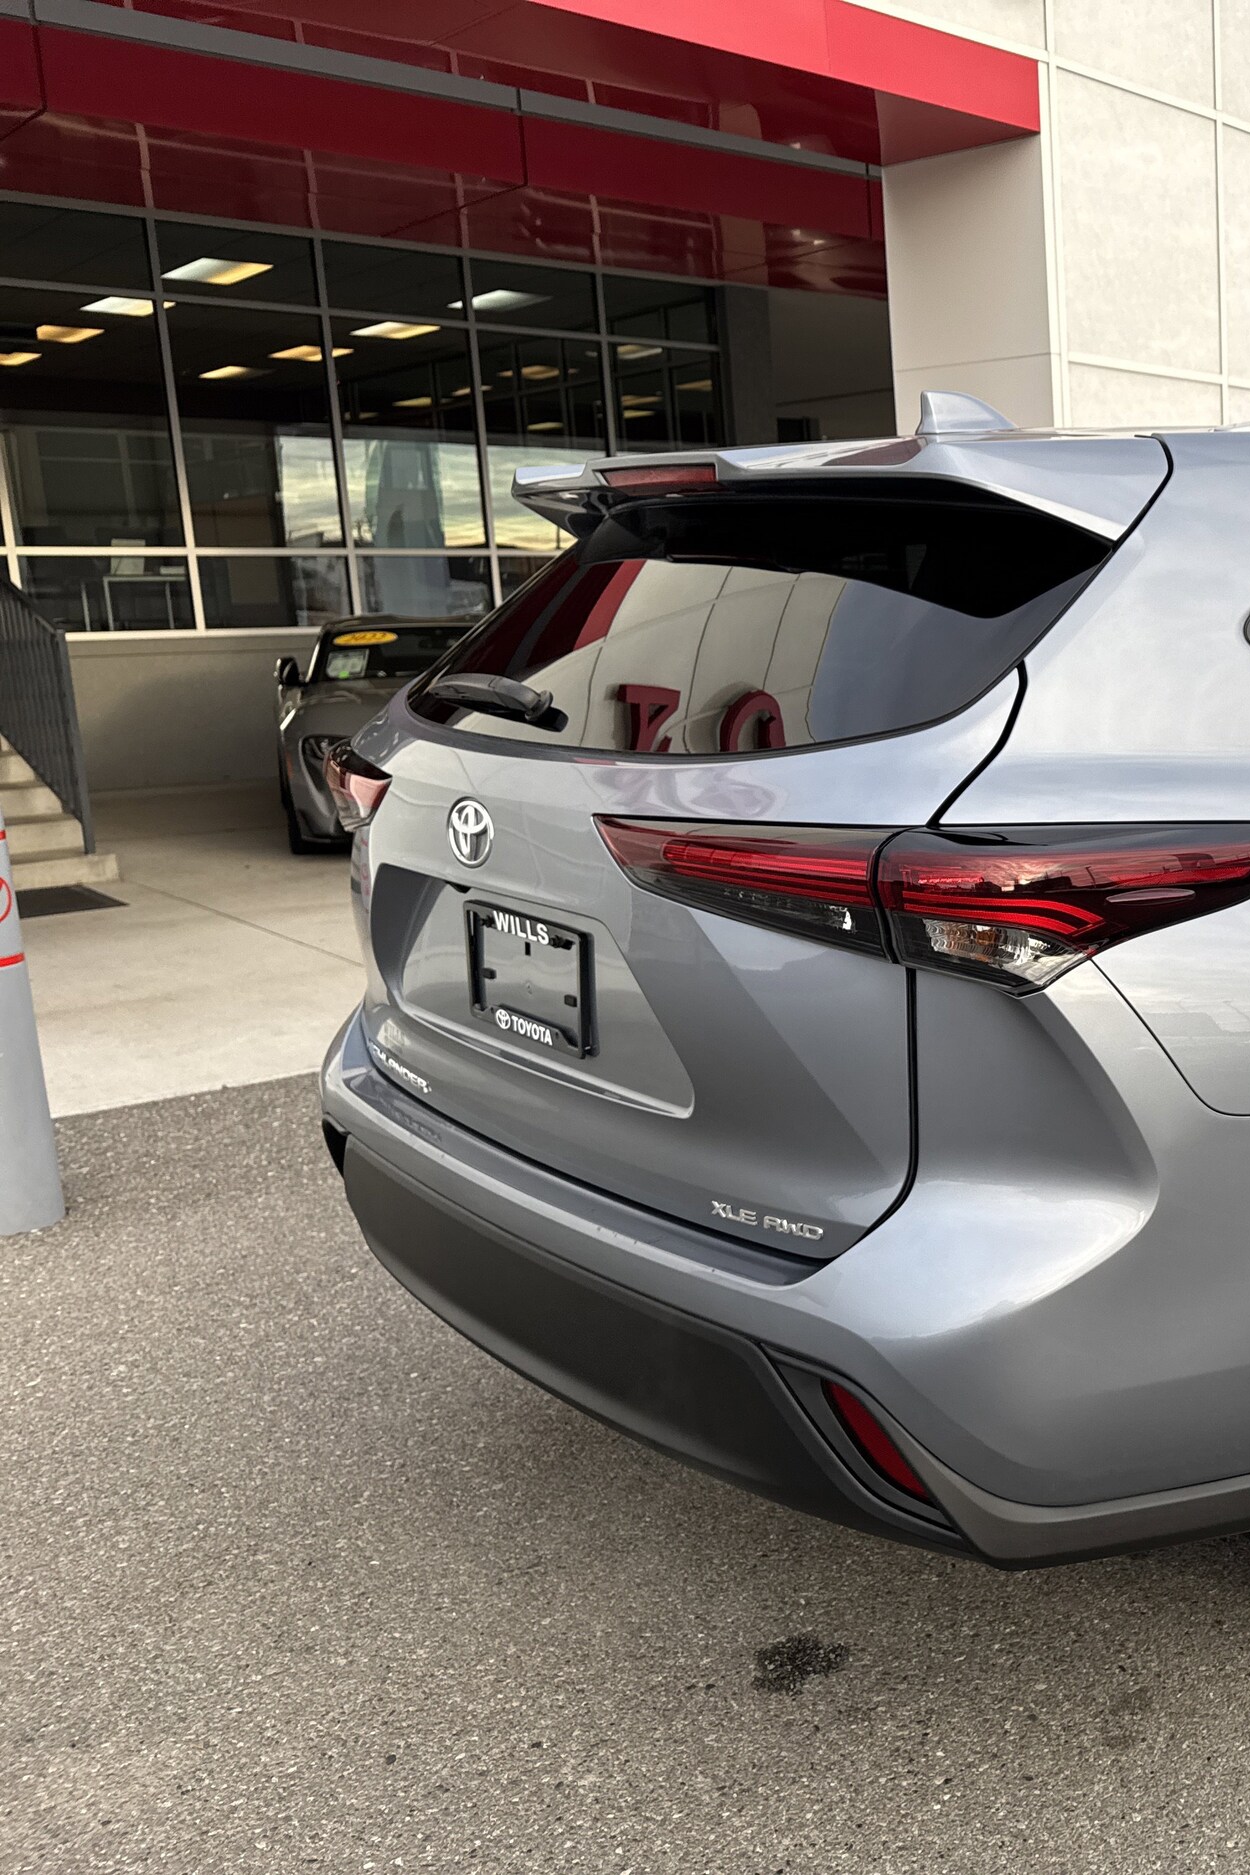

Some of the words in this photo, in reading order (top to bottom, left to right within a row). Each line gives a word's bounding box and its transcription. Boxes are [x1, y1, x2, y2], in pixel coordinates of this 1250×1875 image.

[493, 910, 549, 945] WILLS
[511, 1015, 552, 1046] TOYOTA
[711, 1200, 758, 1226] XLE
[763, 1215, 824, 1241] AWD
